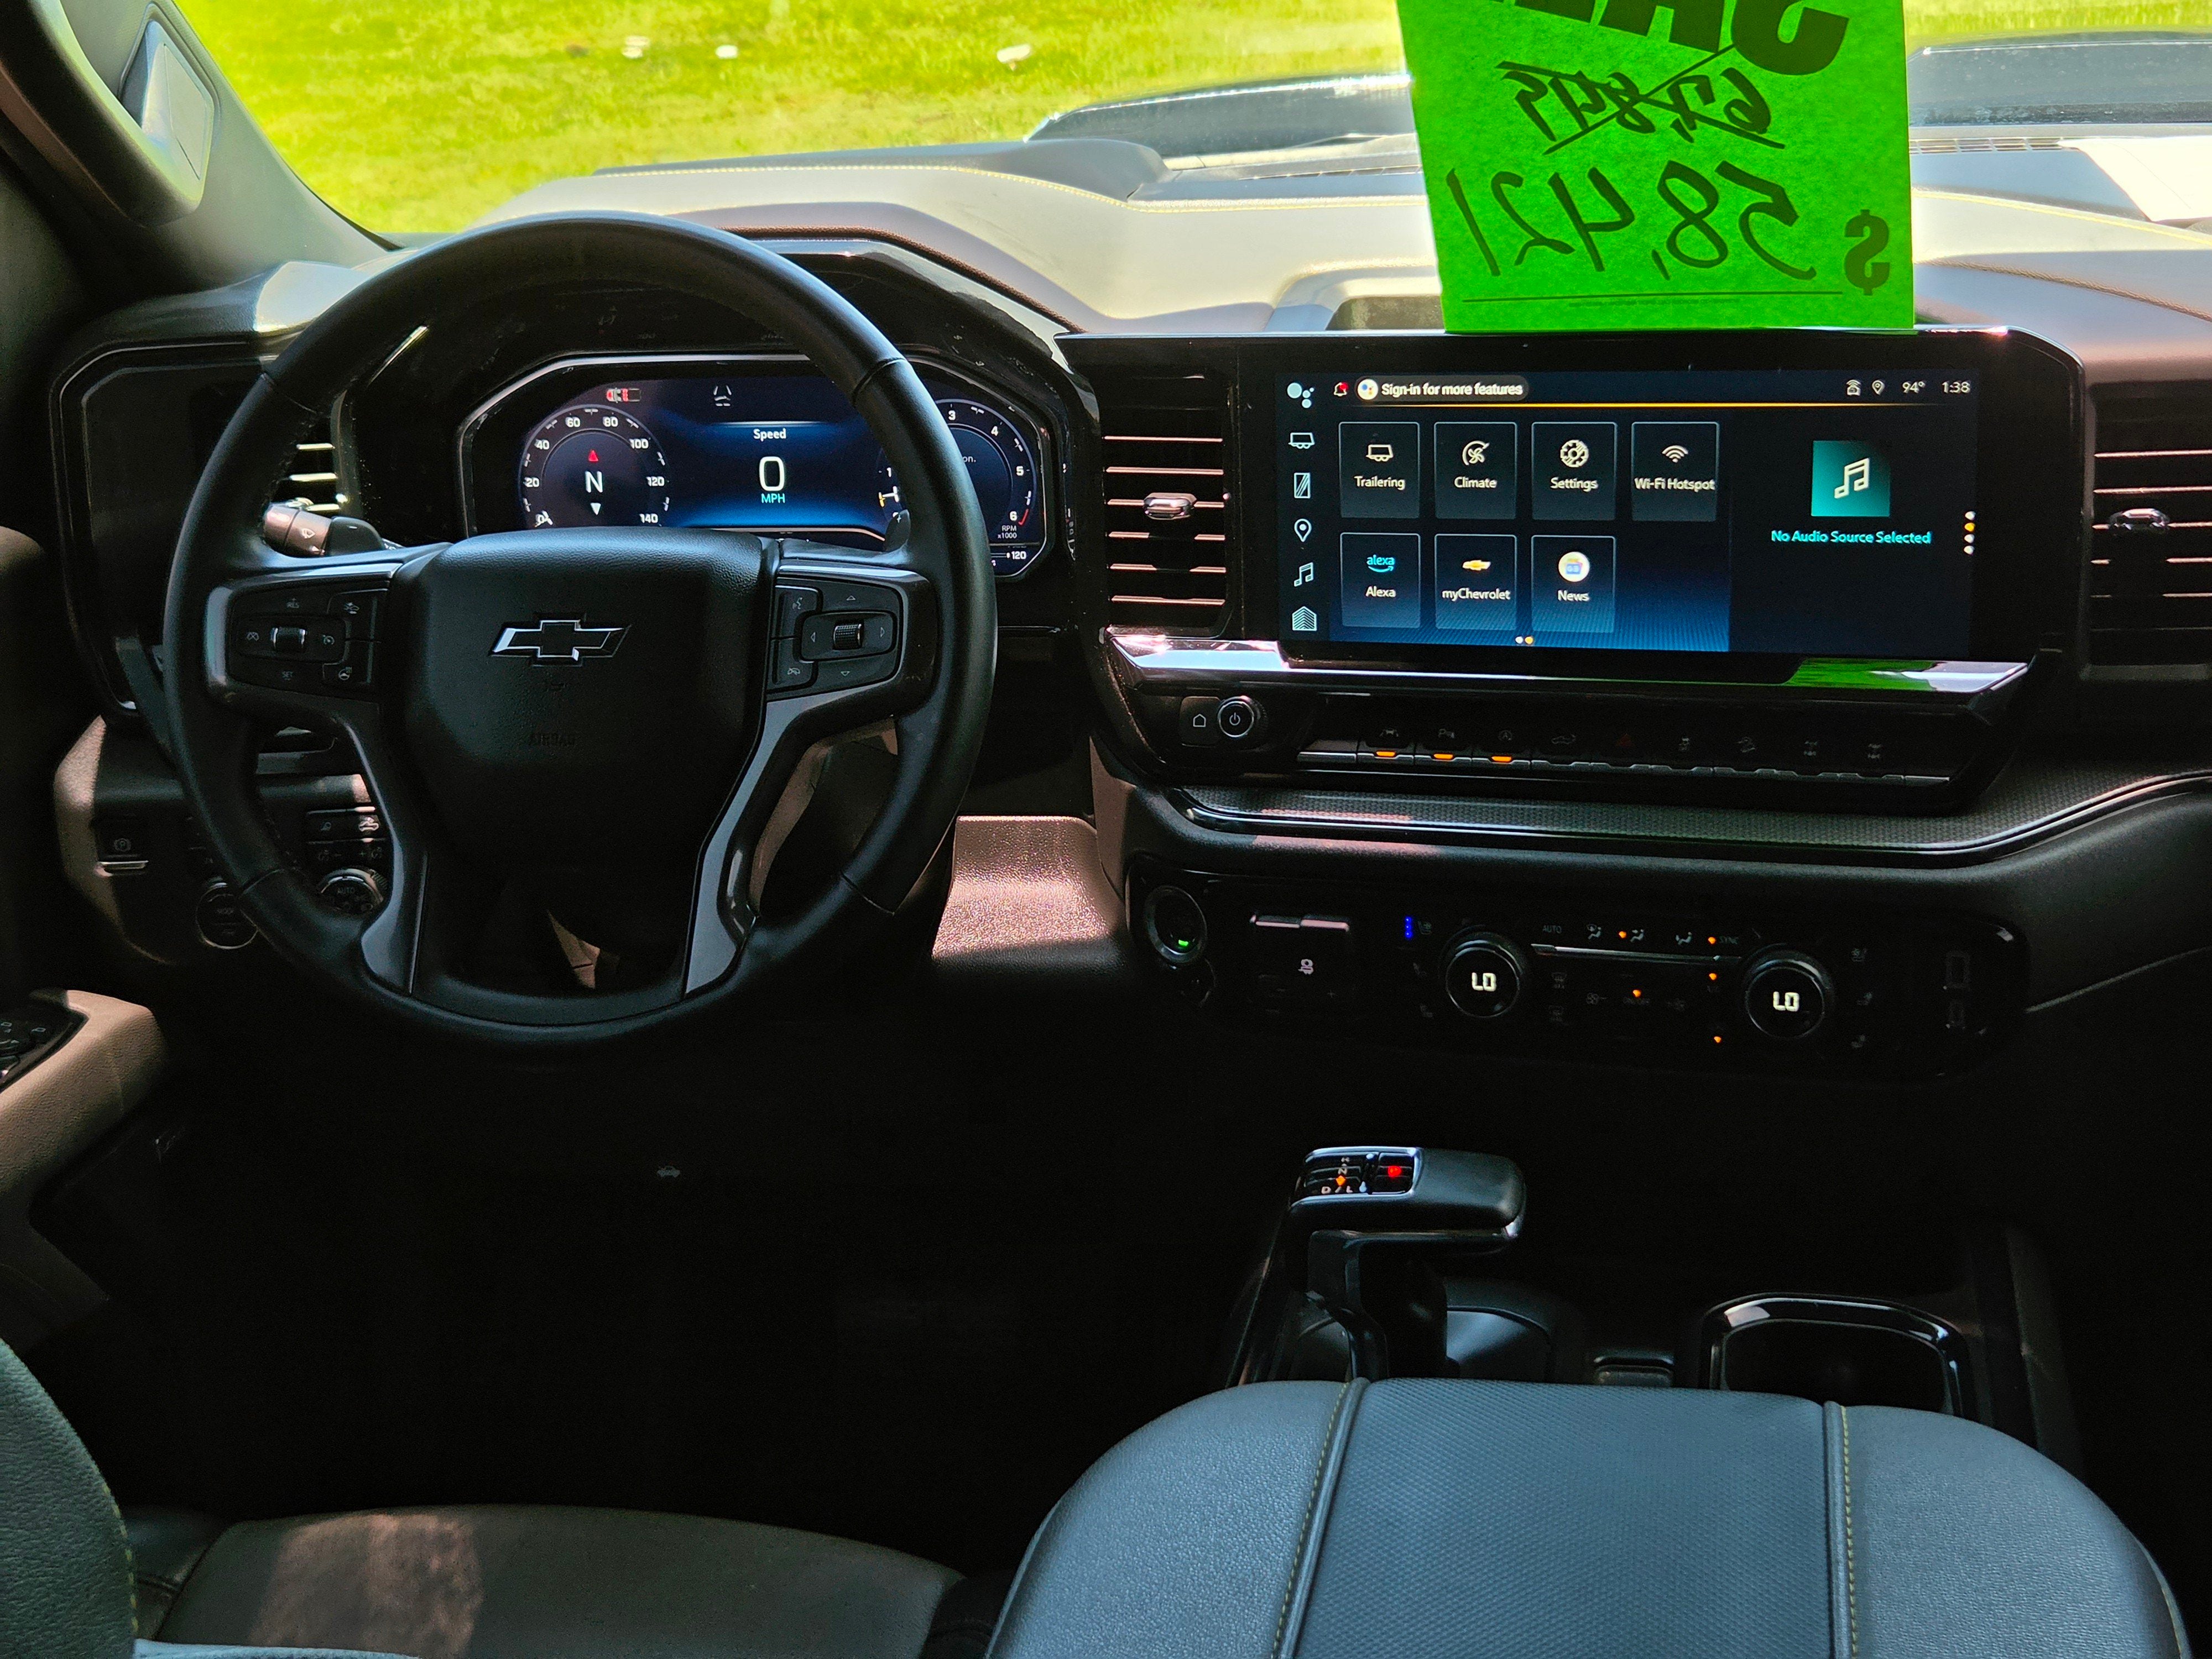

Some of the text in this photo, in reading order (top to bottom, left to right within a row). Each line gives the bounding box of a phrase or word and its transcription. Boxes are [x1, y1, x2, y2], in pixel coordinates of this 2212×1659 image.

[1381, 382, 1524, 397] Sign-in for more features
[1902, 381, 1970, 393] 94° 1:38
[948, 410, 956, 420] 3
[566, 416, 619, 428] 60 80
[753, 429, 787, 441] Speed
[992, 426, 999, 436] 4
[536, 440, 550, 450] 40
[630, 439, 649, 449] 100
[759, 456, 785, 492] 0
[886, 467, 892, 477] 1
[1016, 466, 1024, 476] 5
[526, 477, 540, 488] 20
[585, 471, 603, 493] N
[648, 476, 665, 487] 120
[1354, 476, 1405, 491] Trailering
[1454, 477, 1497, 489] Climate
[1551, 477, 1598, 492] Settings
[1635, 478, 1715, 493] Wi-Fi Hotspot
[761, 493, 786, 504] MPH
[641, 513, 659, 524] 140
[1009, 511, 1018, 521] 6
[1771, 530, 1932, 544] No Audio Source Selected
[1011, 551, 1026, 560] 120
[1366, 555, 1395, 568] alexa
[1365, 586, 1396, 598] Alexa
[1442, 587, 1511, 602] myChevrolet
[1558, 591, 1589, 602] News
[1542, 924, 1563, 934] AUTO
[1471, 972, 1497, 992] LO
[1771, 990, 1801, 1013] LO
